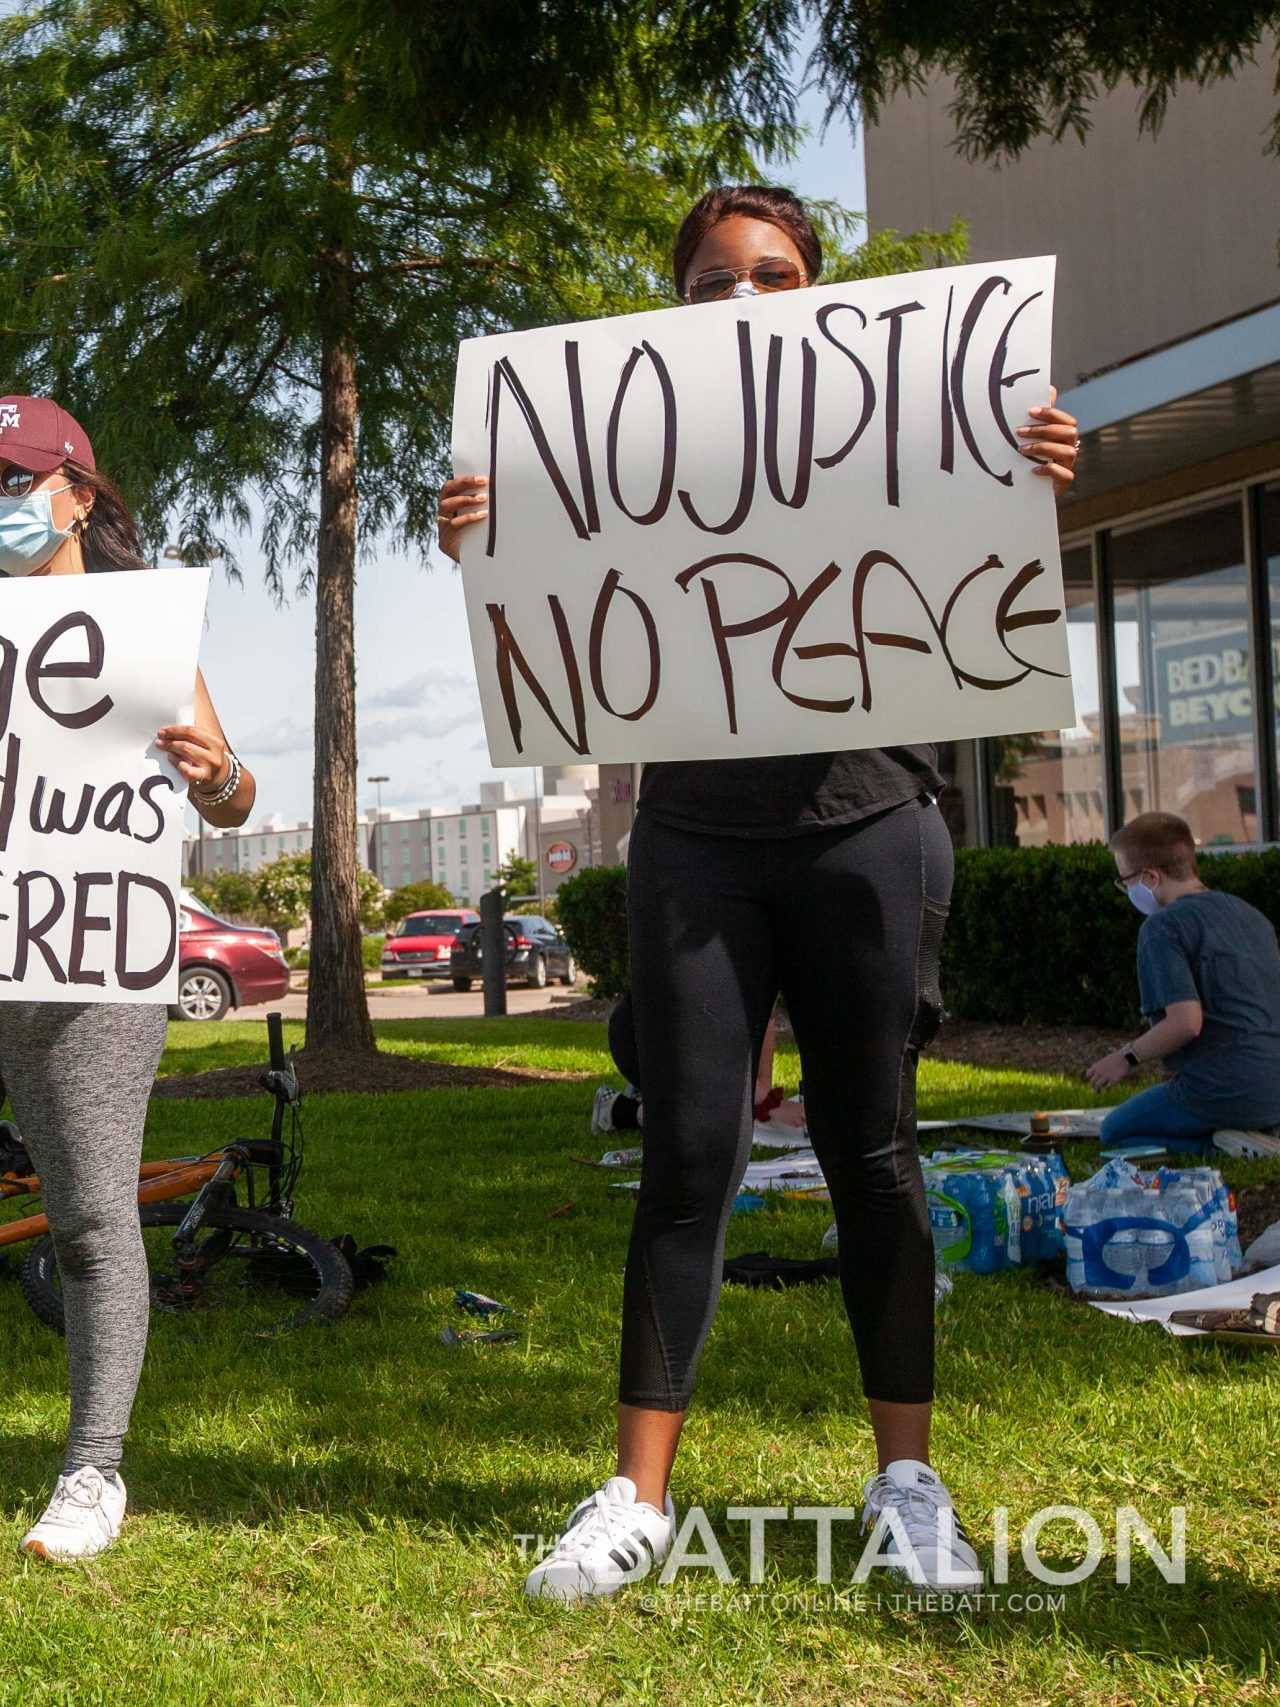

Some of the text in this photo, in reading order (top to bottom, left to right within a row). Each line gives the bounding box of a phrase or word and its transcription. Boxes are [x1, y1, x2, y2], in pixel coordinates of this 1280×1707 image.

[484, 275, 1051, 558] NO JUSTICE
[485, 548, 1072, 756] NO PEACE
[29, 775, 174, 844] was
